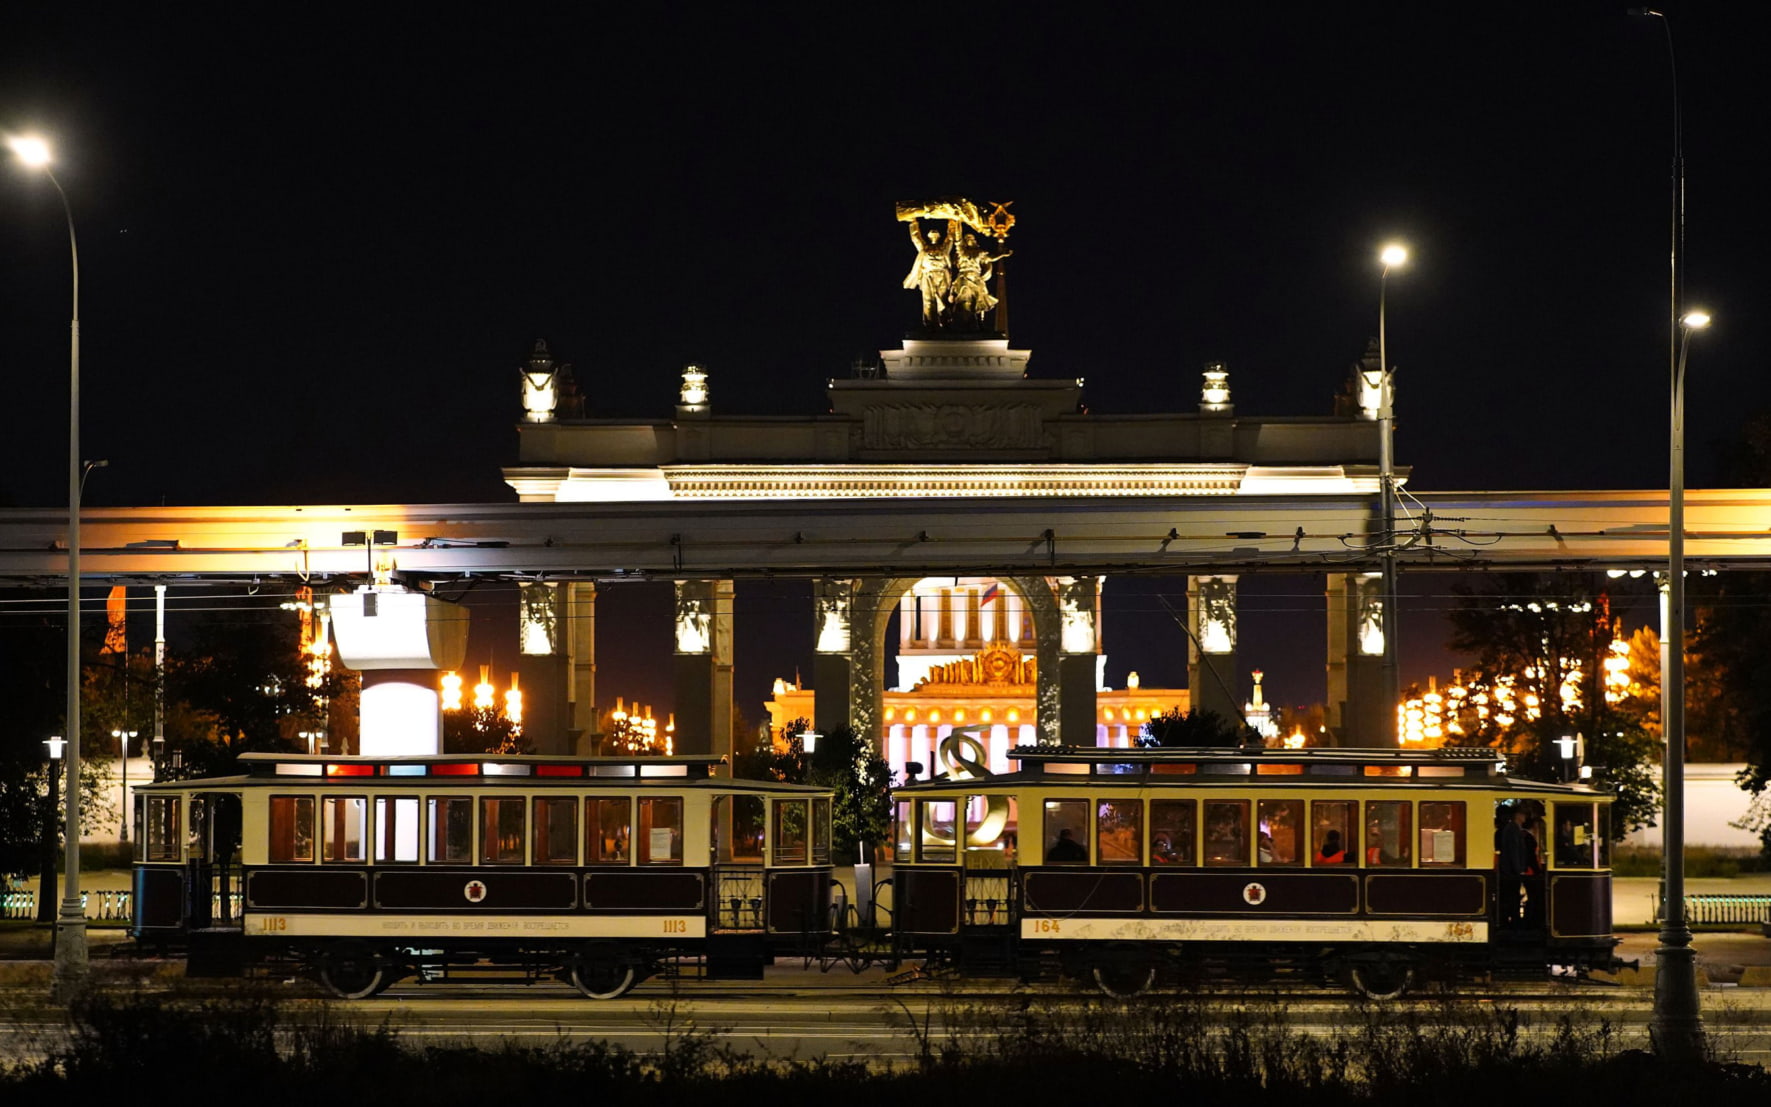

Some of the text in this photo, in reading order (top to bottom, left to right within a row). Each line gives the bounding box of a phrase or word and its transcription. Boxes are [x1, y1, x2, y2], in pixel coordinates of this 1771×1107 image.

[263, 917, 286, 931] 1113
[663, 919, 687, 933] 1113
[1034, 919, 1061, 934] 164
